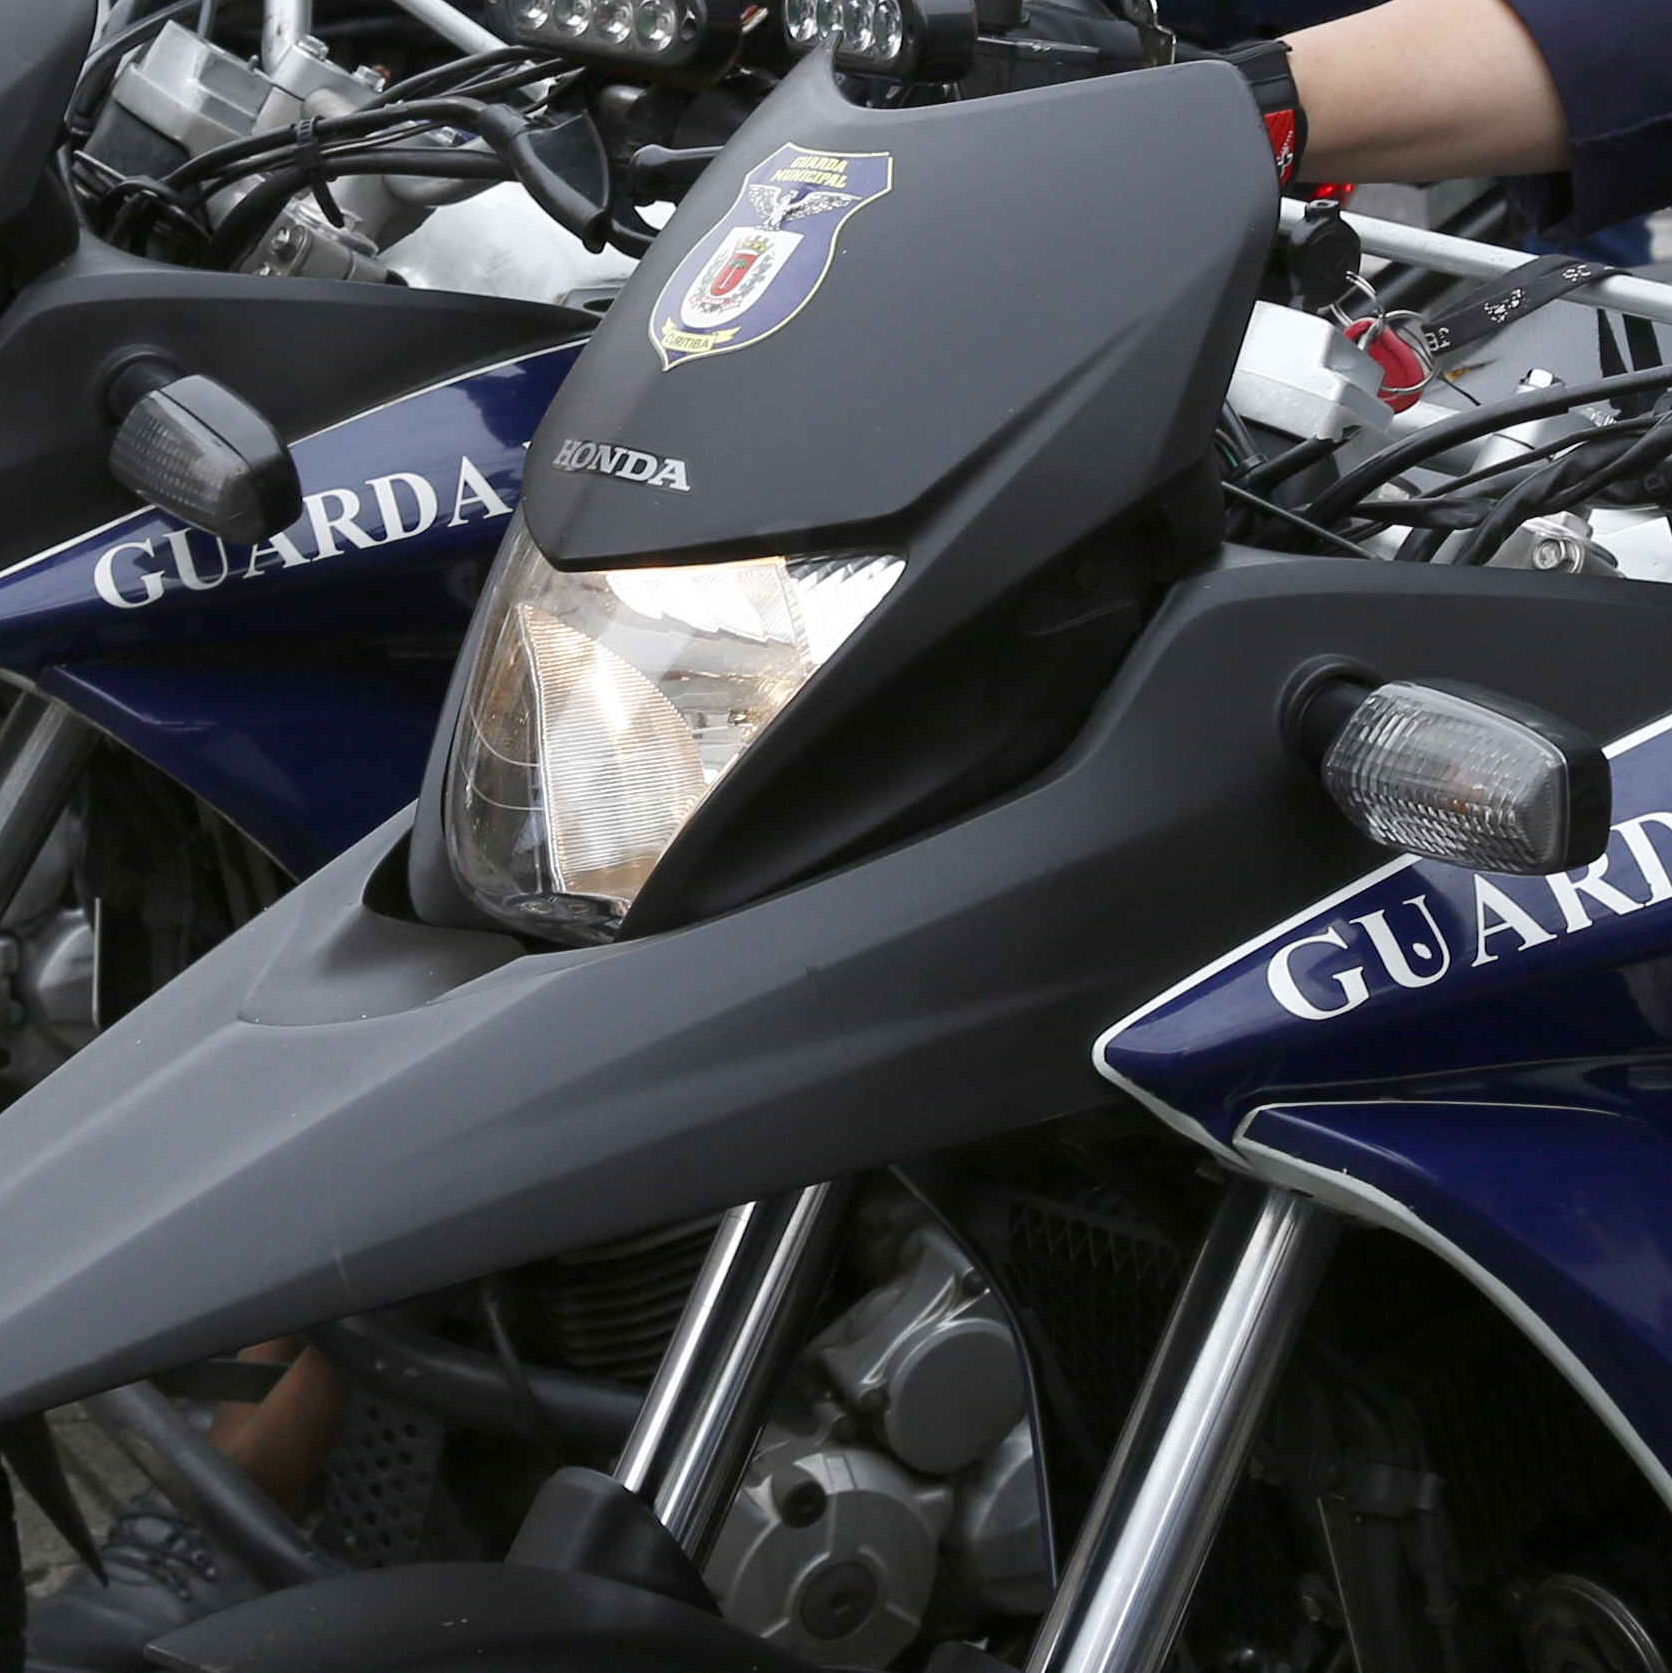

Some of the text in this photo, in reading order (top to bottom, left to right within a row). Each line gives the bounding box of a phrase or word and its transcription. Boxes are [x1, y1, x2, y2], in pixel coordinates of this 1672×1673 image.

[791, 156, 849, 173] GUARDA
[770, 169, 849, 189] MUNICIPAL
[664, 332, 710, 351] CURITIBA
[552, 439, 692, 492] HONDA
